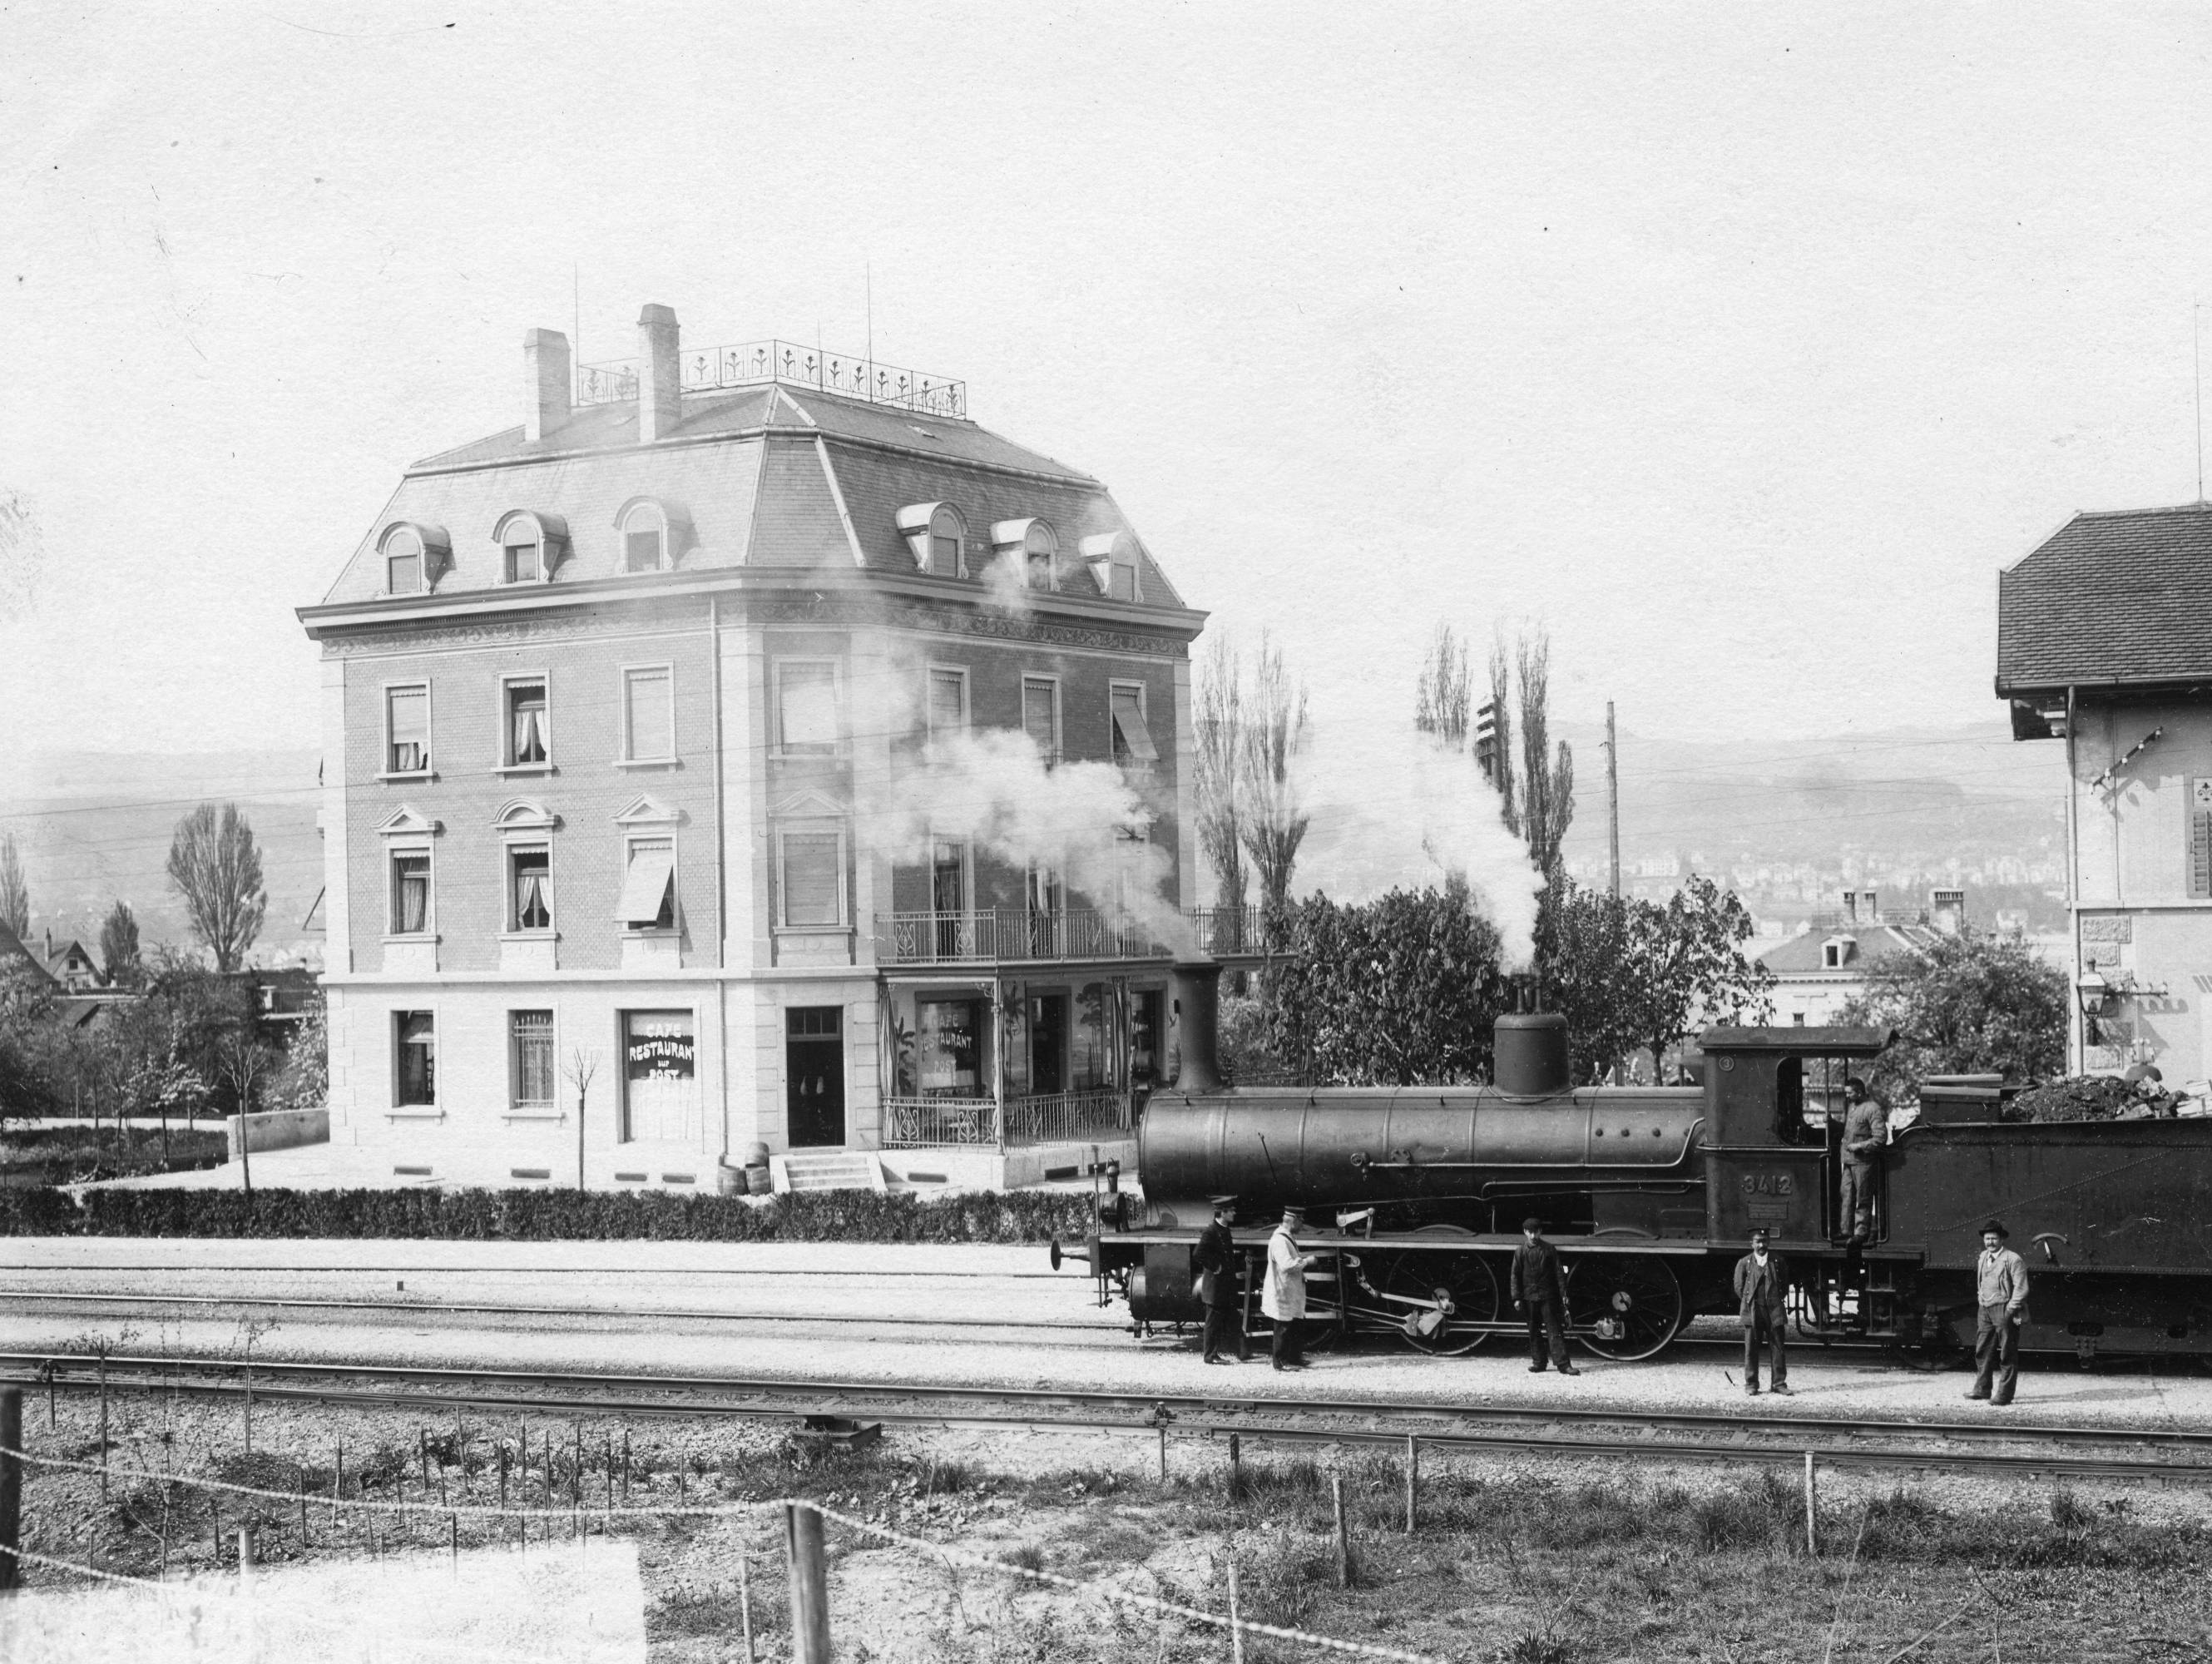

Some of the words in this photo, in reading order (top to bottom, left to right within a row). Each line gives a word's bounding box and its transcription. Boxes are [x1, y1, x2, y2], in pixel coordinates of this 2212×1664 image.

[646, 1023, 681, 1038] CAFE
[934, 1059, 957, 1072] POST
[649, 1069, 679, 1081] POST
[1744, 1175, 1791, 1195] 3412
